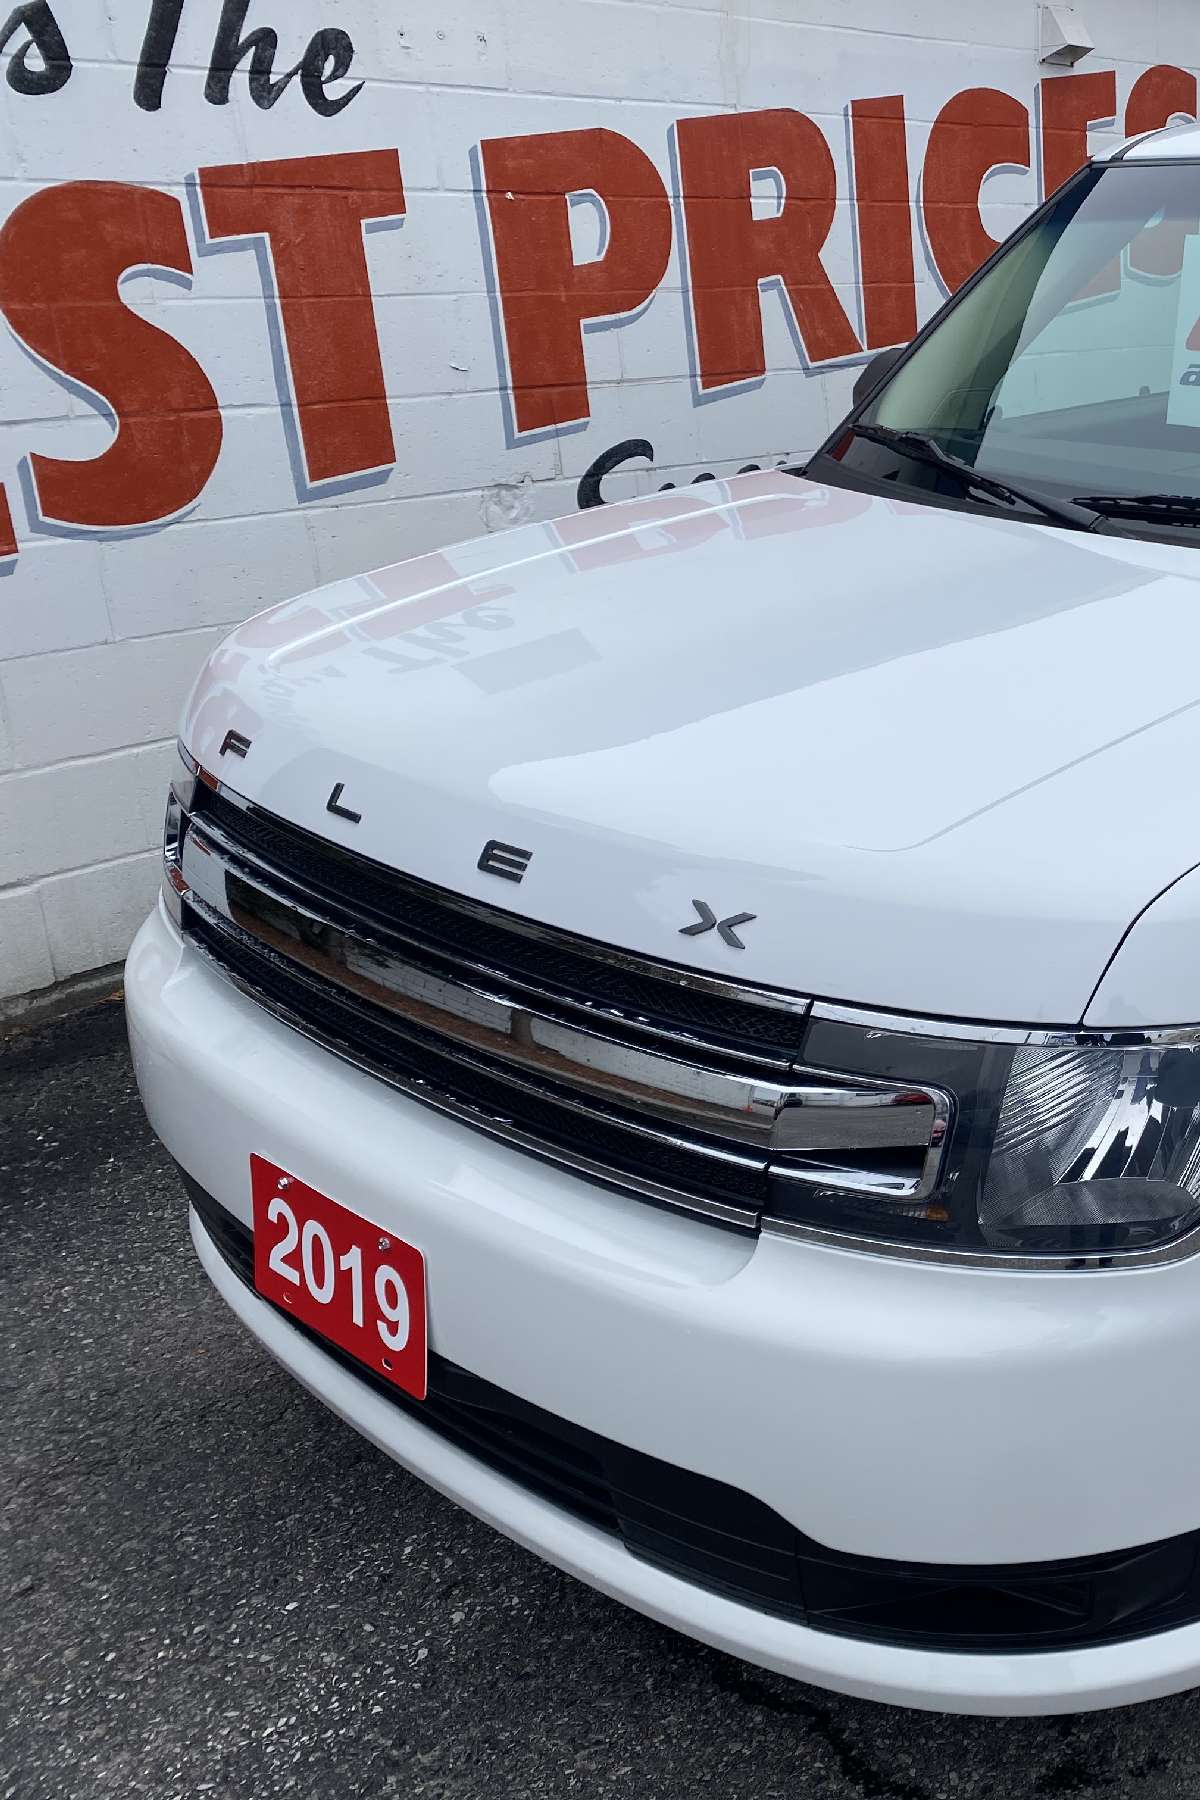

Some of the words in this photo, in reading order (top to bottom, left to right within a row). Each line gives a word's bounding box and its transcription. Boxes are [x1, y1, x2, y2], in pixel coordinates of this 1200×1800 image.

[0, 148, 406, 576] ST
[219, 729, 757, 950] FLEX
[267, 1197, 410, 1352] 2019
